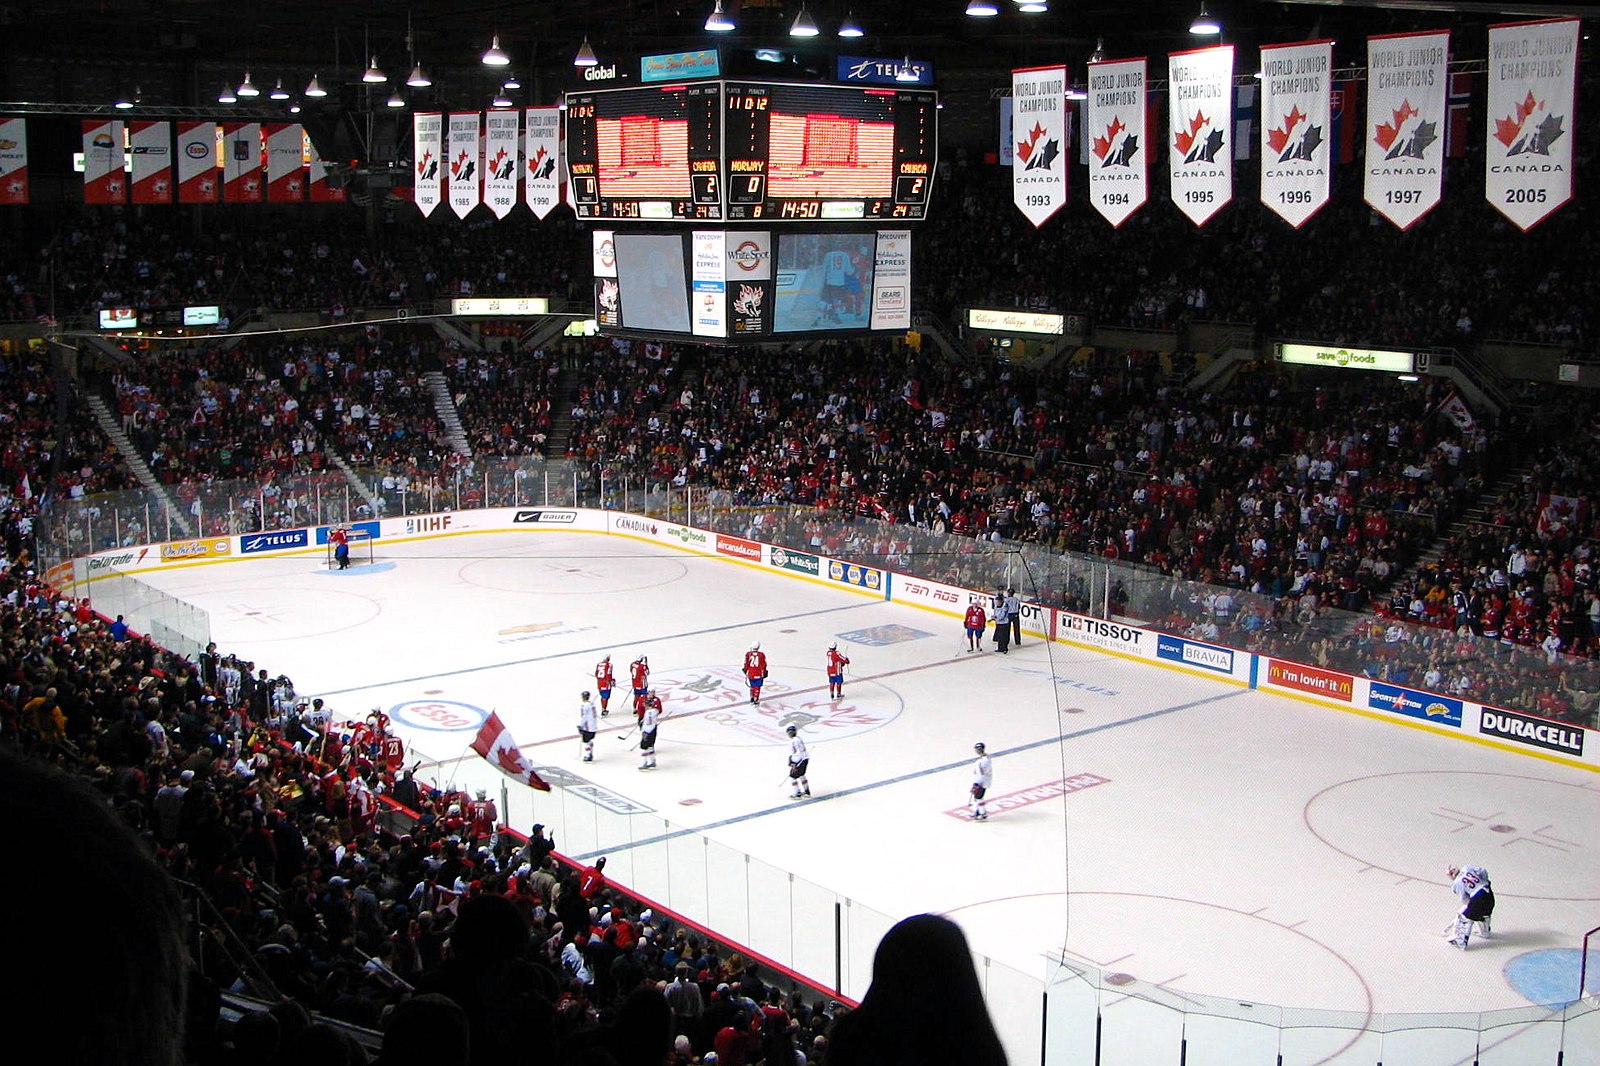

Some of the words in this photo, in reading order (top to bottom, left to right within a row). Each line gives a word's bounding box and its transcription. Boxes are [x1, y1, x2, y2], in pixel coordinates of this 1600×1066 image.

[1493, 40, 1528, 59] WORLD
[1531, 37, 1572, 56] JUNIOR
[1372, 51, 1404, 68] WORLD
[1407, 47, 1443, 66] JUNIOR
[584, 65, 615, 81] Global
[1264, 60, 1292, 77] WORLD
[1295, 56, 1326, 74] JUNIOR
[1501, 60, 1562, 81] CHAMPIONS
[1092, 75, 1115, 90] WORLD
[1118, 72, 1142, 87] JUNIOR
[1271, 77, 1319, 95] CHAMPIONS
[1379, 69, 1434, 89] CHAMPIONS
[1015, 82, 1036, 96] WORLD
[1038, 80, 1062, 95] JUNIOR
[1020, 98, 1056, 113] CHAMPIONS
[1097, 91, 1136, 107] CHAMPIONS
[731, 160, 764, 171] NORWAY
[1266, 169, 1325, 177] CANADA
[1371, 168, 1437, 176] CANADA
[1491, 164, 1563, 173] CANADA
[1173, 170, 1225, 178] CANADA
[706, 177, 715, 193] 2
[748, 176, 760, 193] 0
[912, 178, 923, 194] 2
[455, 198, 470, 206] 1985
[494, 197, 510, 206] 1988
[533, 197, 549, 205] 1990
[1025, 195, 1051, 206] 1993
[1102, 194, 1129, 205] 1994
[1185, 191, 1214, 203] 1995
[1279, 190, 1312, 203] 1996
[1385, 190, 1422, 203] 1997
[1505, 189, 1546, 203] 2005
[781, 202, 820, 218] 14:50
[872, 202, 881, 214] 2
[893, 205, 908, 217] 24
[1317, 352, 1336, 361] save
[1350, 352, 1375, 364] foods
[416, 515, 452, 532] IIHF
[615, 518, 650, 534] CANADIAN
[266, 535, 301, 546] TELUS
[717, 540, 761, 558] aircanada.com
[904, 582, 929, 596] TSN
[1084, 618, 1142, 644] TISSOT
[749, 655, 759, 668] 24
[1159, 643, 1179, 653] SONY
[1186, 648, 1228, 666] BRAVIA
[1282, 669, 1297, 682] i'm
[1299, 673, 1328, 689] lovin'
[1329, 678, 1338, 691] it
[1482, 712, 1581, 750] DURACELL
[388, 741, 400, 756] 23
